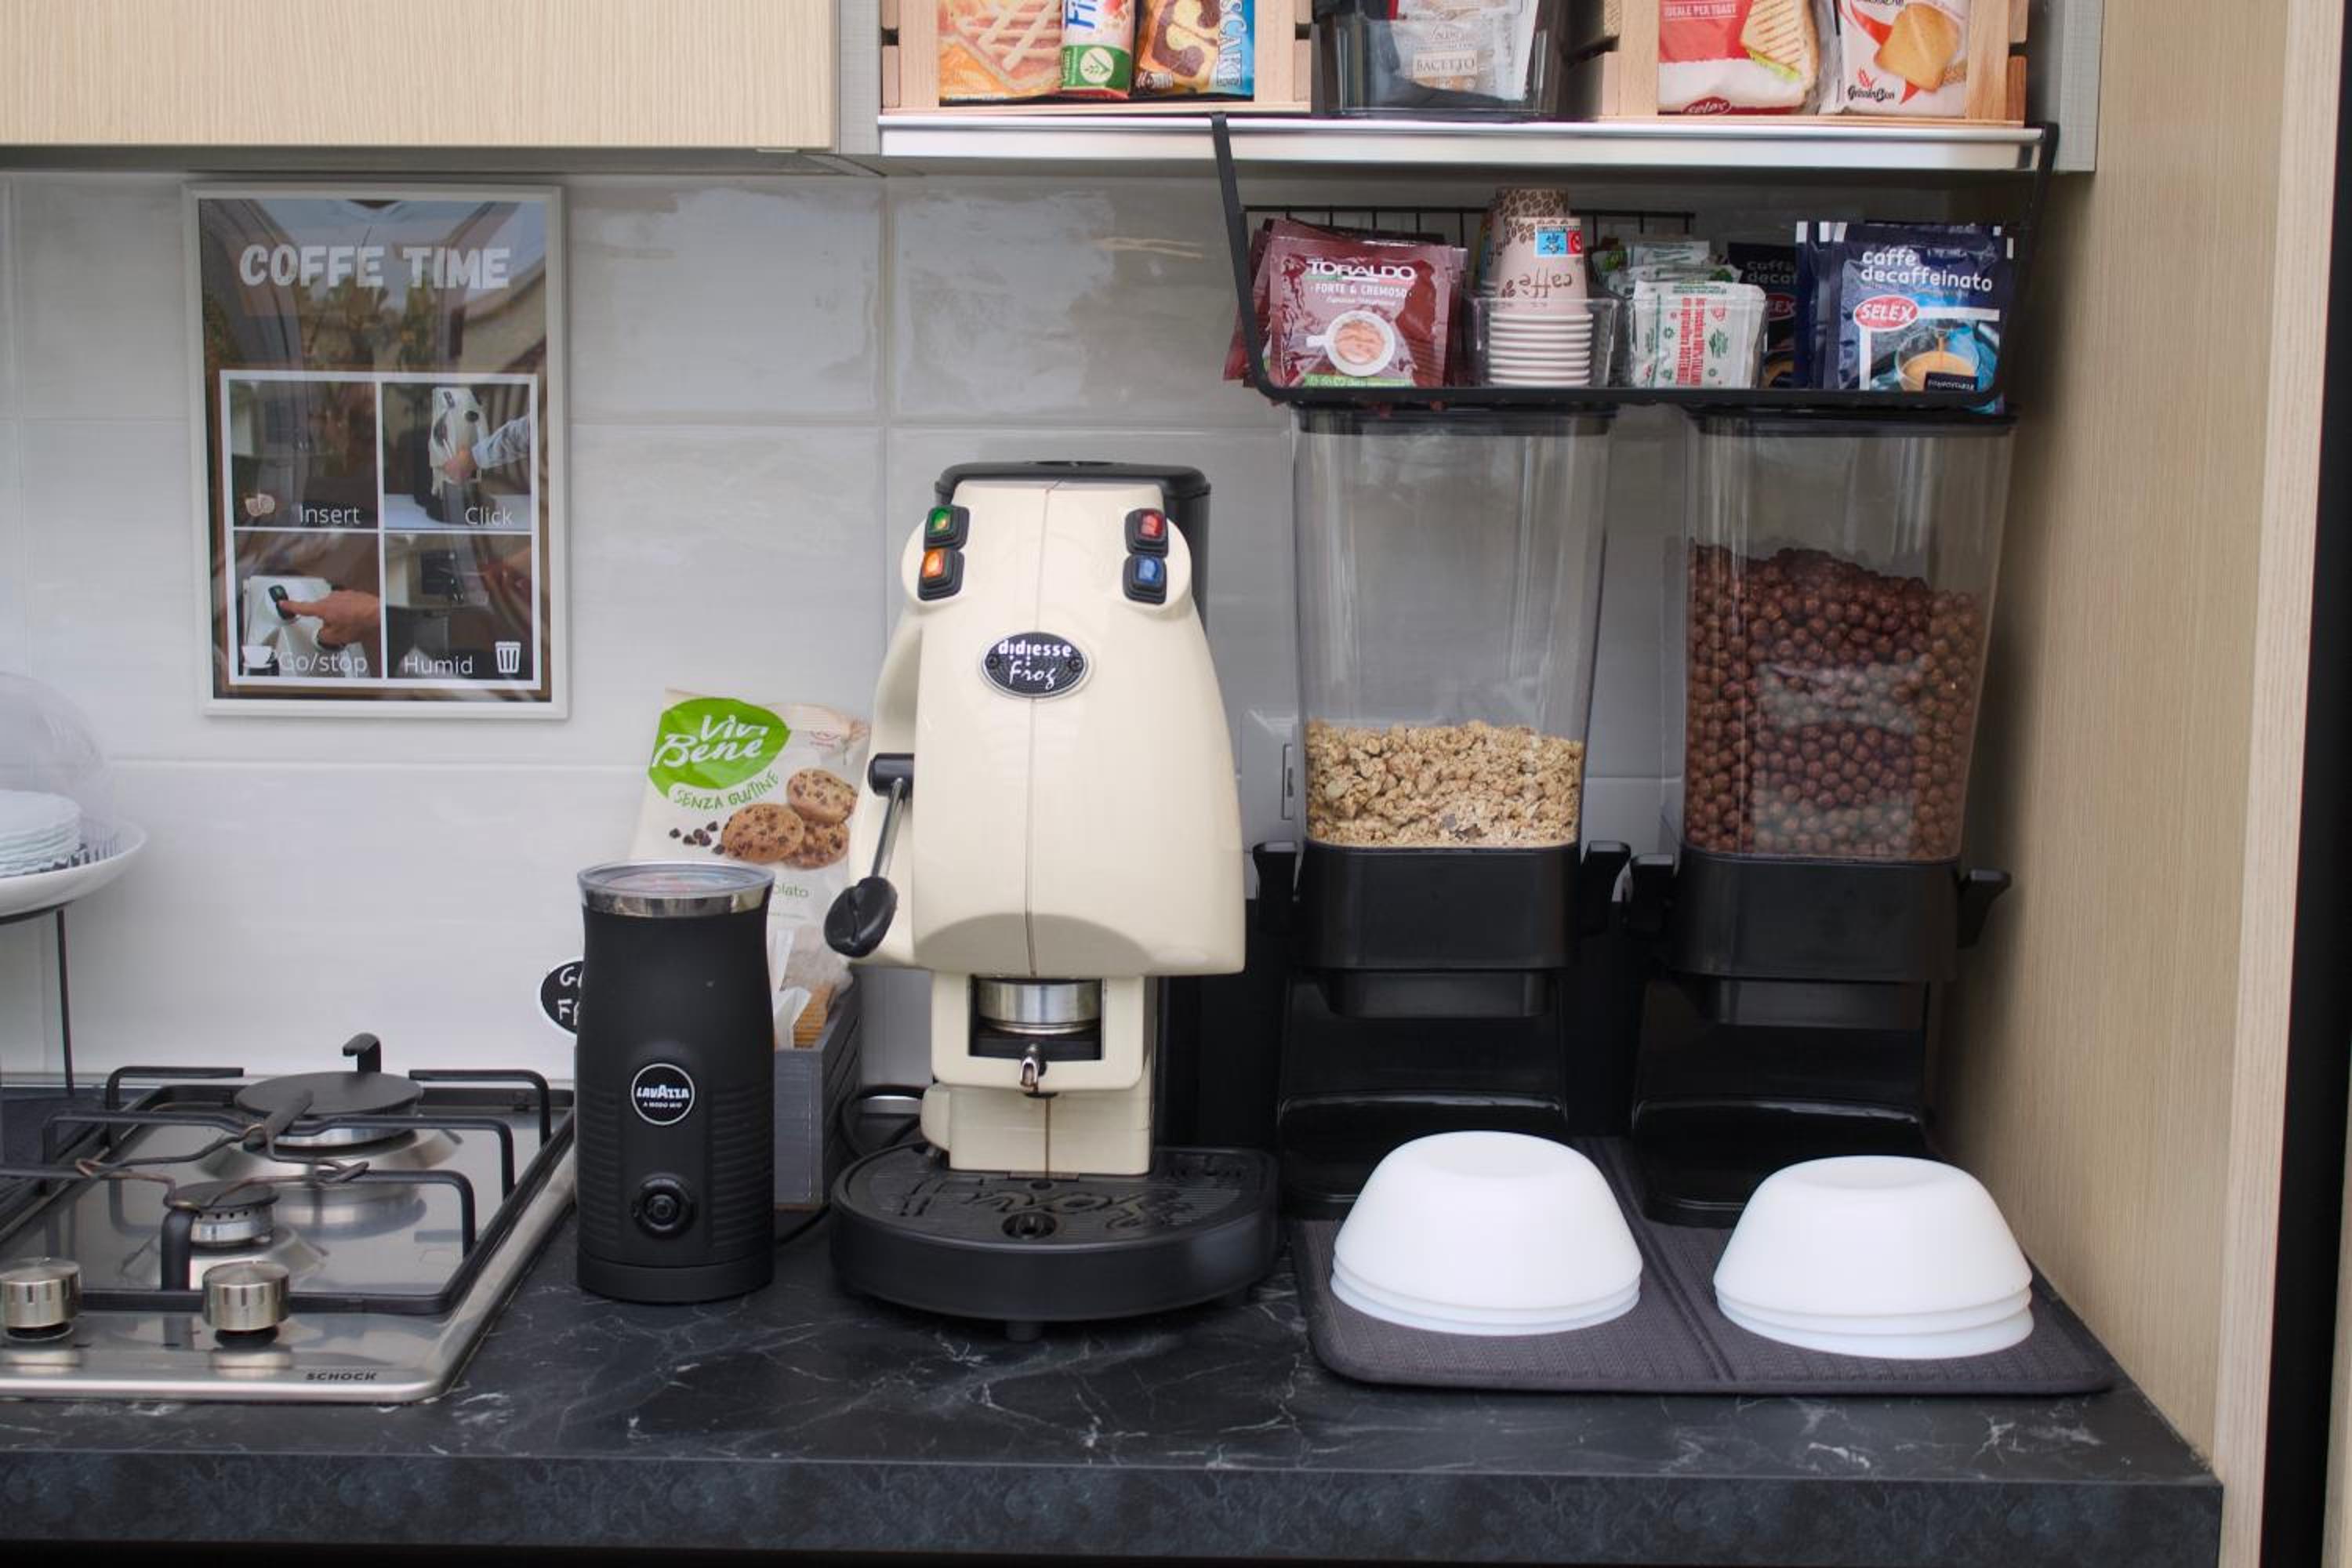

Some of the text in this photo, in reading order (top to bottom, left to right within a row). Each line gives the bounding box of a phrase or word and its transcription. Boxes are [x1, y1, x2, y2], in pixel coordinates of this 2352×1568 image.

[239, 245, 512, 290] COFFE TIME
[1861, 248, 1918, 267] caffè
[1305, 260, 1417, 281] TORALDO
[1860, 266, 1993, 292] decaffeinato
[1314, 283, 1346, 295] FORTE
[1360, 285, 1407, 299] CREMOSO
[1860, 303, 1915, 321] SELEX
[299, 505, 361, 526] Insert
[464, 506, 513, 526] Click
[998, 639, 1072, 666] didiesse
[278, 651, 368, 677] Go/stop
[403, 655, 474, 675] Humid
[652, 733, 764, 768] Bene
[673, 789, 724, 811] SENZA
[636, 1084, 690, 1099] LAVAZZA
